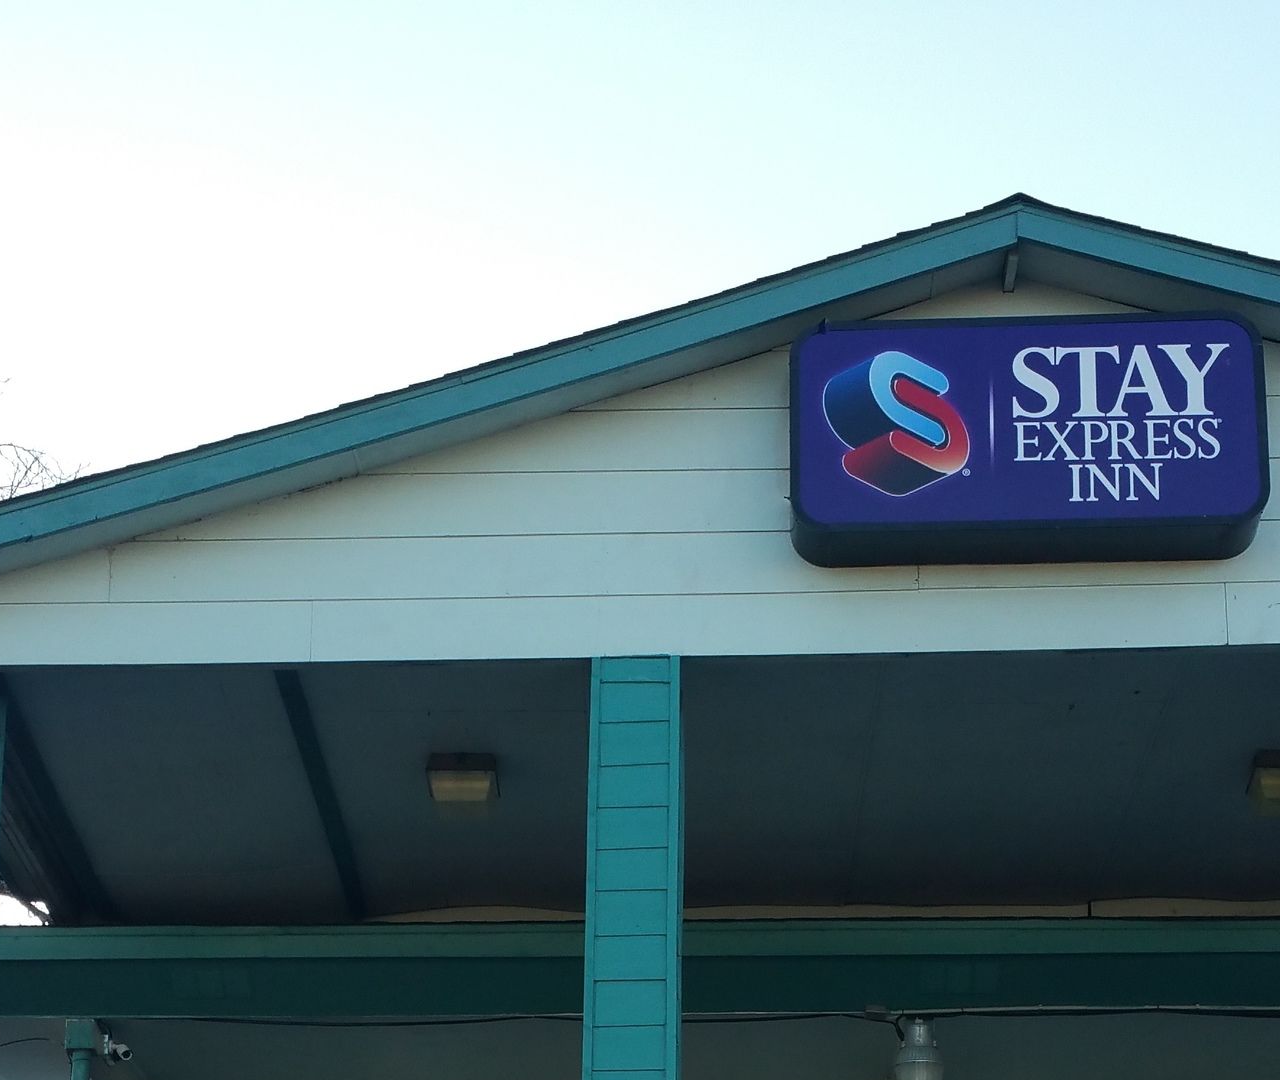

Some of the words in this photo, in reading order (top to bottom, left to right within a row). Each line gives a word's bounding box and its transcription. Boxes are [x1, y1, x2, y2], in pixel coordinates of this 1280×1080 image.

[1012, 343, 1230, 419] STAY
[1013, 417, 1221, 462] EXPRESS
[1068, 462, 1164, 502] INN
